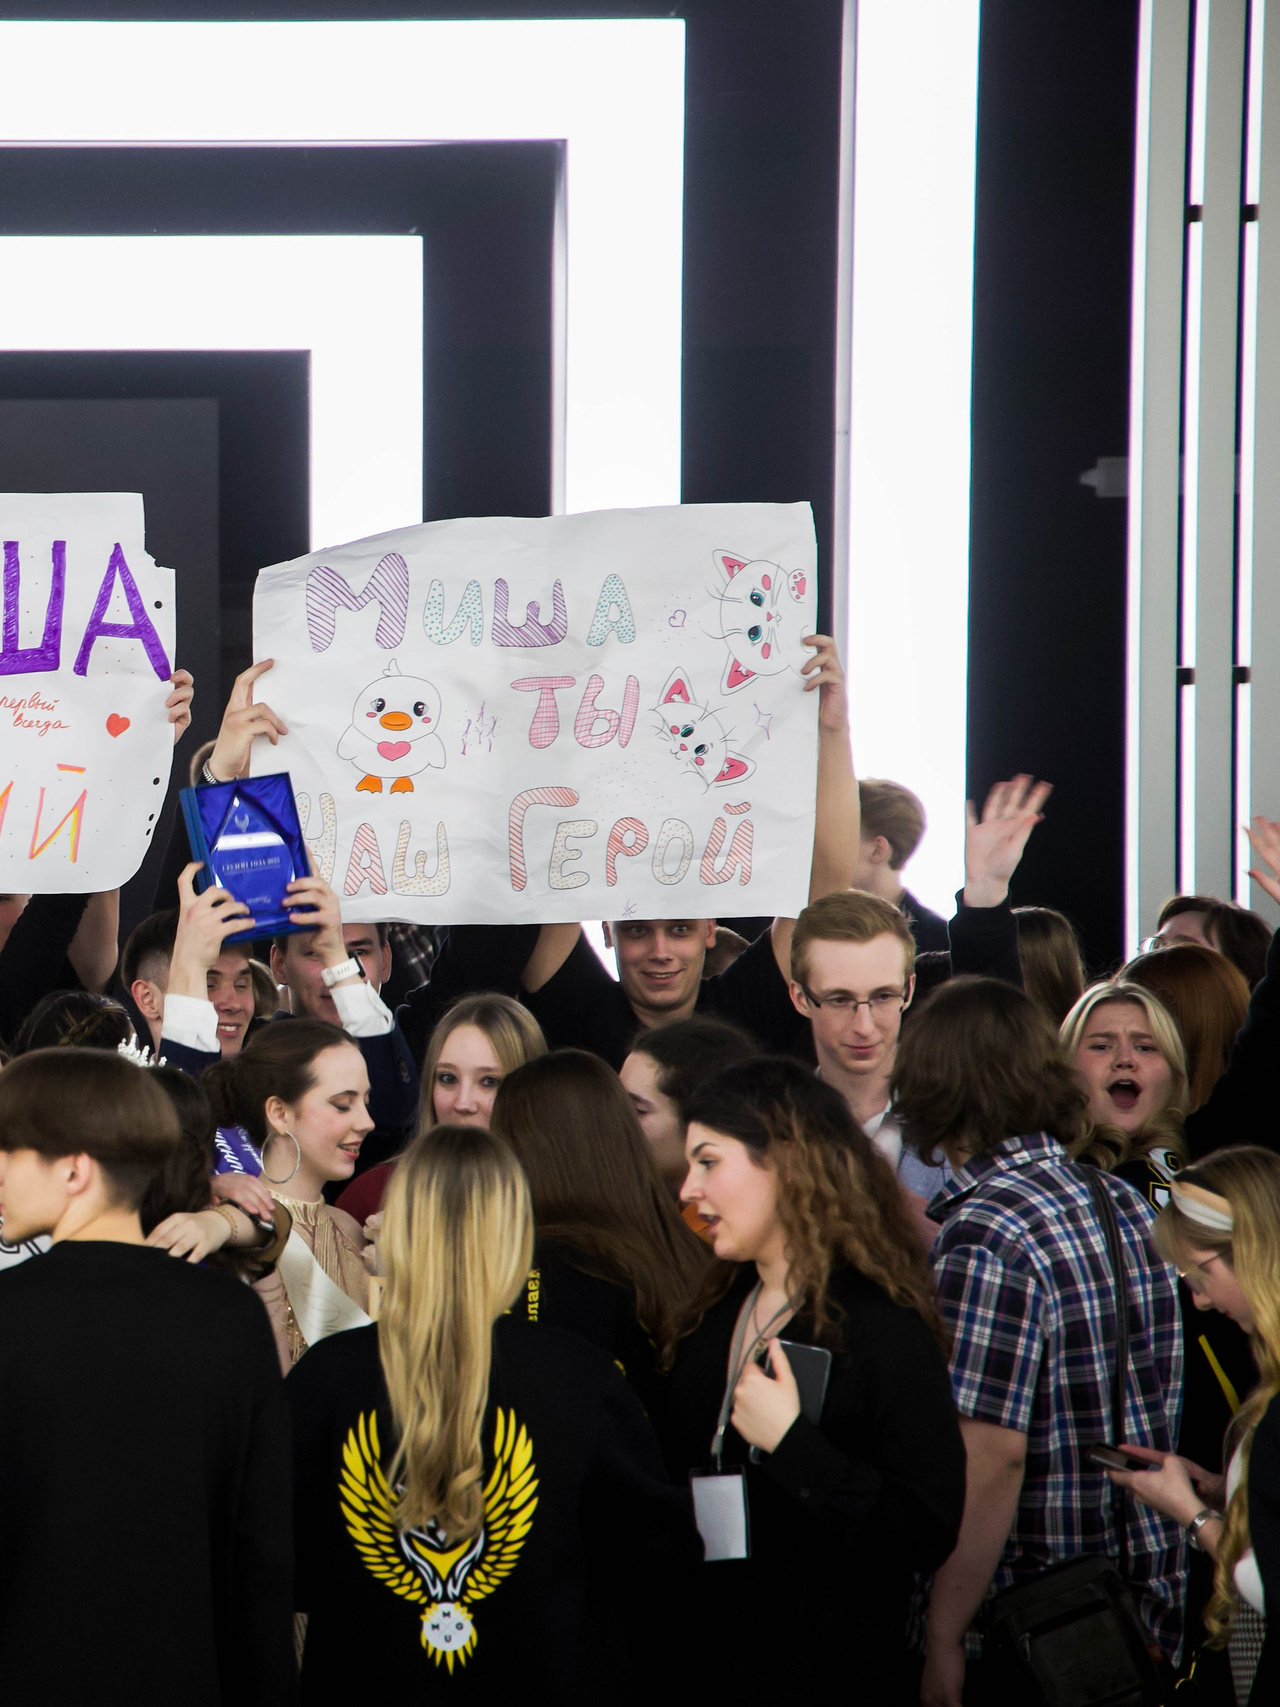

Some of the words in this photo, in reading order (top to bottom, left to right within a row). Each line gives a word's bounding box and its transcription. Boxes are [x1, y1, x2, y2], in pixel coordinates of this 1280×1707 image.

[12, 714, 71, 738] всегда
[510, 674, 641, 749] ТЫ
[294, 792, 451, 898] НАШ
[508, 785, 755, 893] ГЕРОЙ
